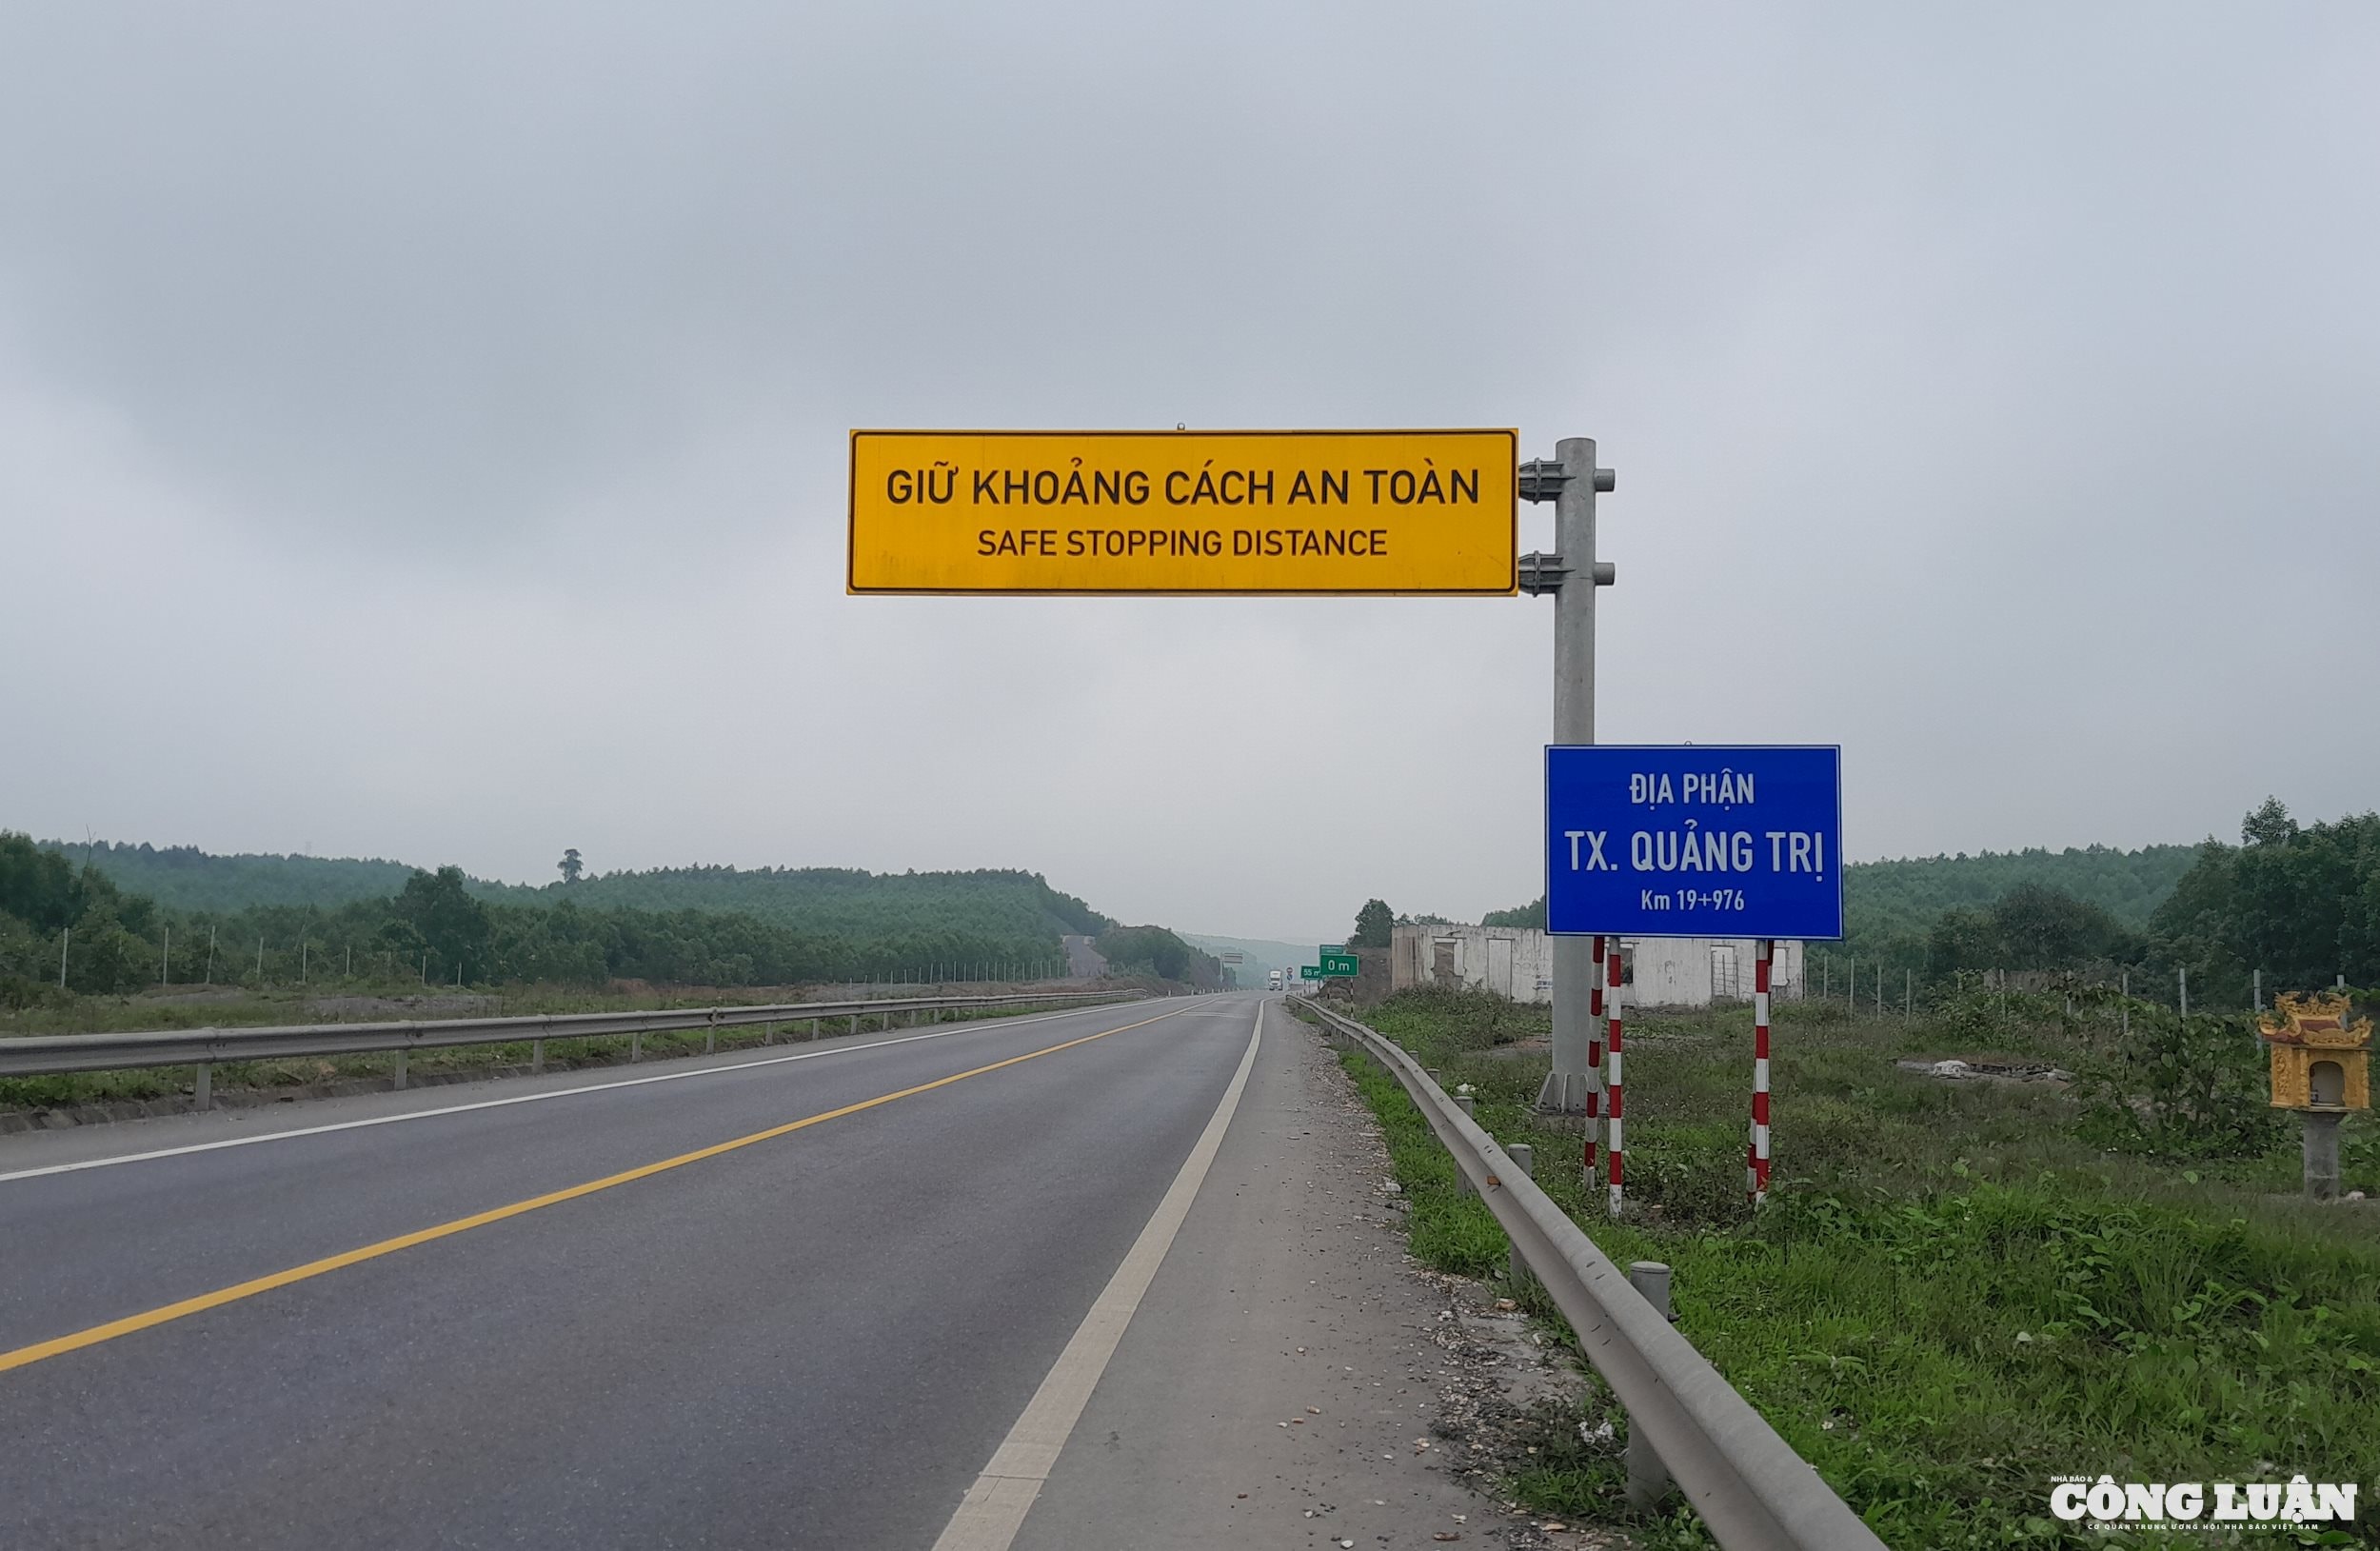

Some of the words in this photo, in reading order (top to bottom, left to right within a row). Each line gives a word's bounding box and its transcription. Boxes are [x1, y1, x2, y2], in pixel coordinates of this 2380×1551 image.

[886, 460, 960, 505] GIỮ
[972, 457, 1150, 505] KHOẢNG
[1164, 459, 1274, 506] CÁCH
[1286, 469, 1349, 506] AN
[1362, 457, 1479, 505] TOÀN
[977, 529, 1058, 557] SAFE
[1065, 529, 1222, 557] STOPPING
[1232, 529, 1388, 557] DISTANCE
[1629, 772, 1675, 811] ĐỊA
[1682, 767, 1755, 811] PHẬN
[1564, 830, 1618, 871] TX.
[1631, 818, 1754, 872] QUẢNG
[1765, 830, 1823, 882] TRỊ
[1640, 888, 1671, 911] Km
[1676, 888, 1745, 911] 19+976
[1328, 960, 1336, 971] 0
[1339, 963, 1350, 971] m
